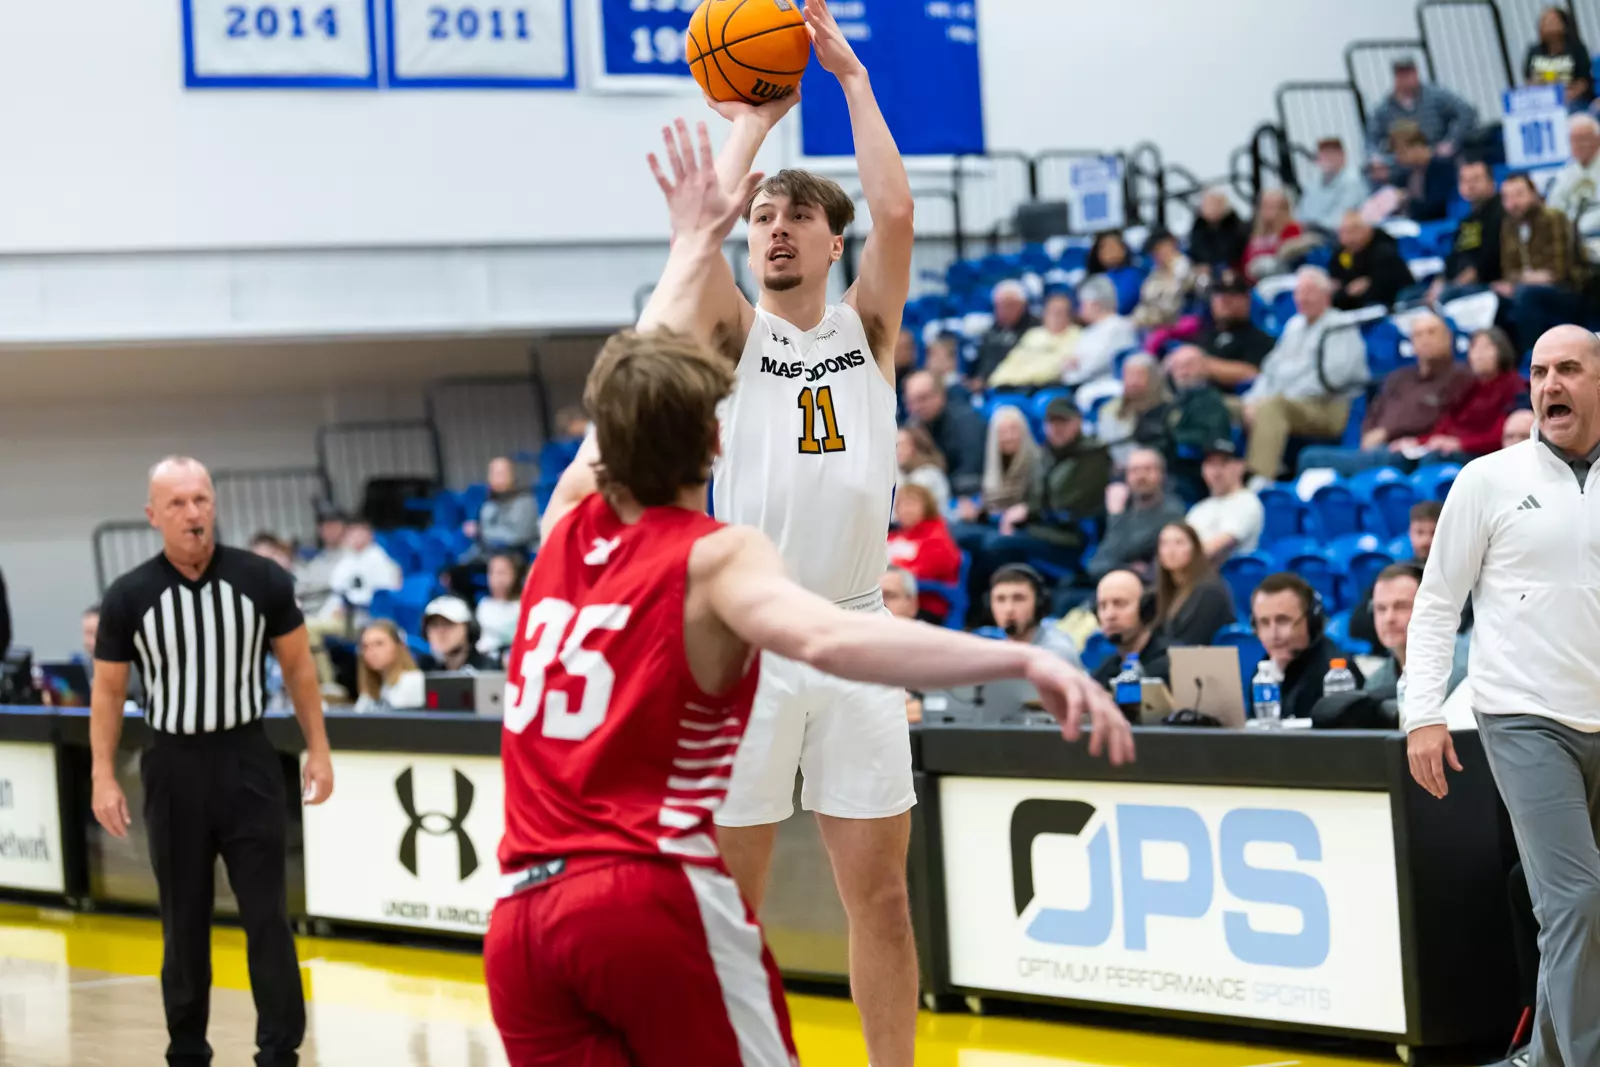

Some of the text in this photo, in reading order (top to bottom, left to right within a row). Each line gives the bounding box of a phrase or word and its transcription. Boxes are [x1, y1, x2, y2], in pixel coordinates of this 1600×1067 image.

[224, 5, 340, 40] 2014
[427, 7, 533, 41] 2011
[760, 349, 865, 381] MASODONS
[797, 385, 846, 454] 11
[503, 597, 632, 740] 35
[1010, 798, 1330, 970] OPS
[382, 900, 428, 920] UNDER
[1017, 956, 1331, 1011] OPTIMUM PERFORMANCE SPORTS
